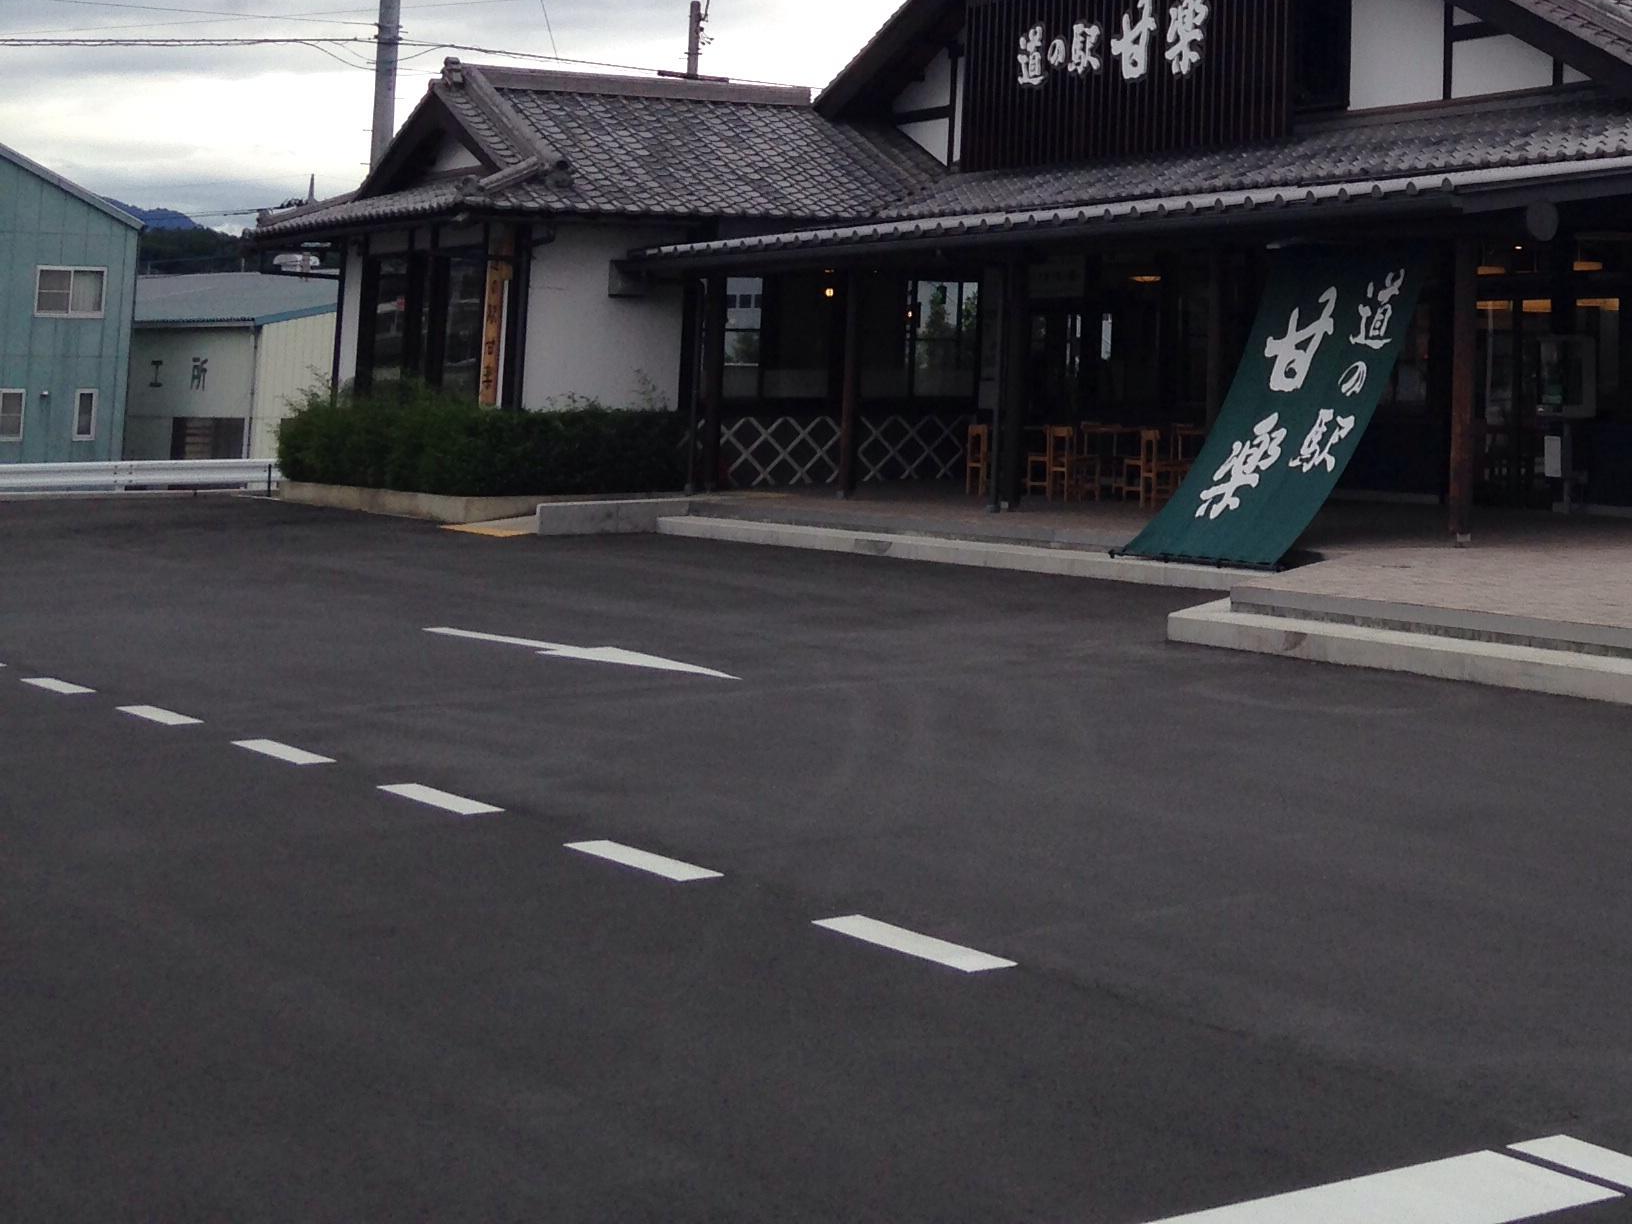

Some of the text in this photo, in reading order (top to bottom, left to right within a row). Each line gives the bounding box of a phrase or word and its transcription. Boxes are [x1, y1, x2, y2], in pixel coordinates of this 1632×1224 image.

[1195, 285, 1338, 520] 甘楽
[1288, 268, 1405, 472] 道の駅
